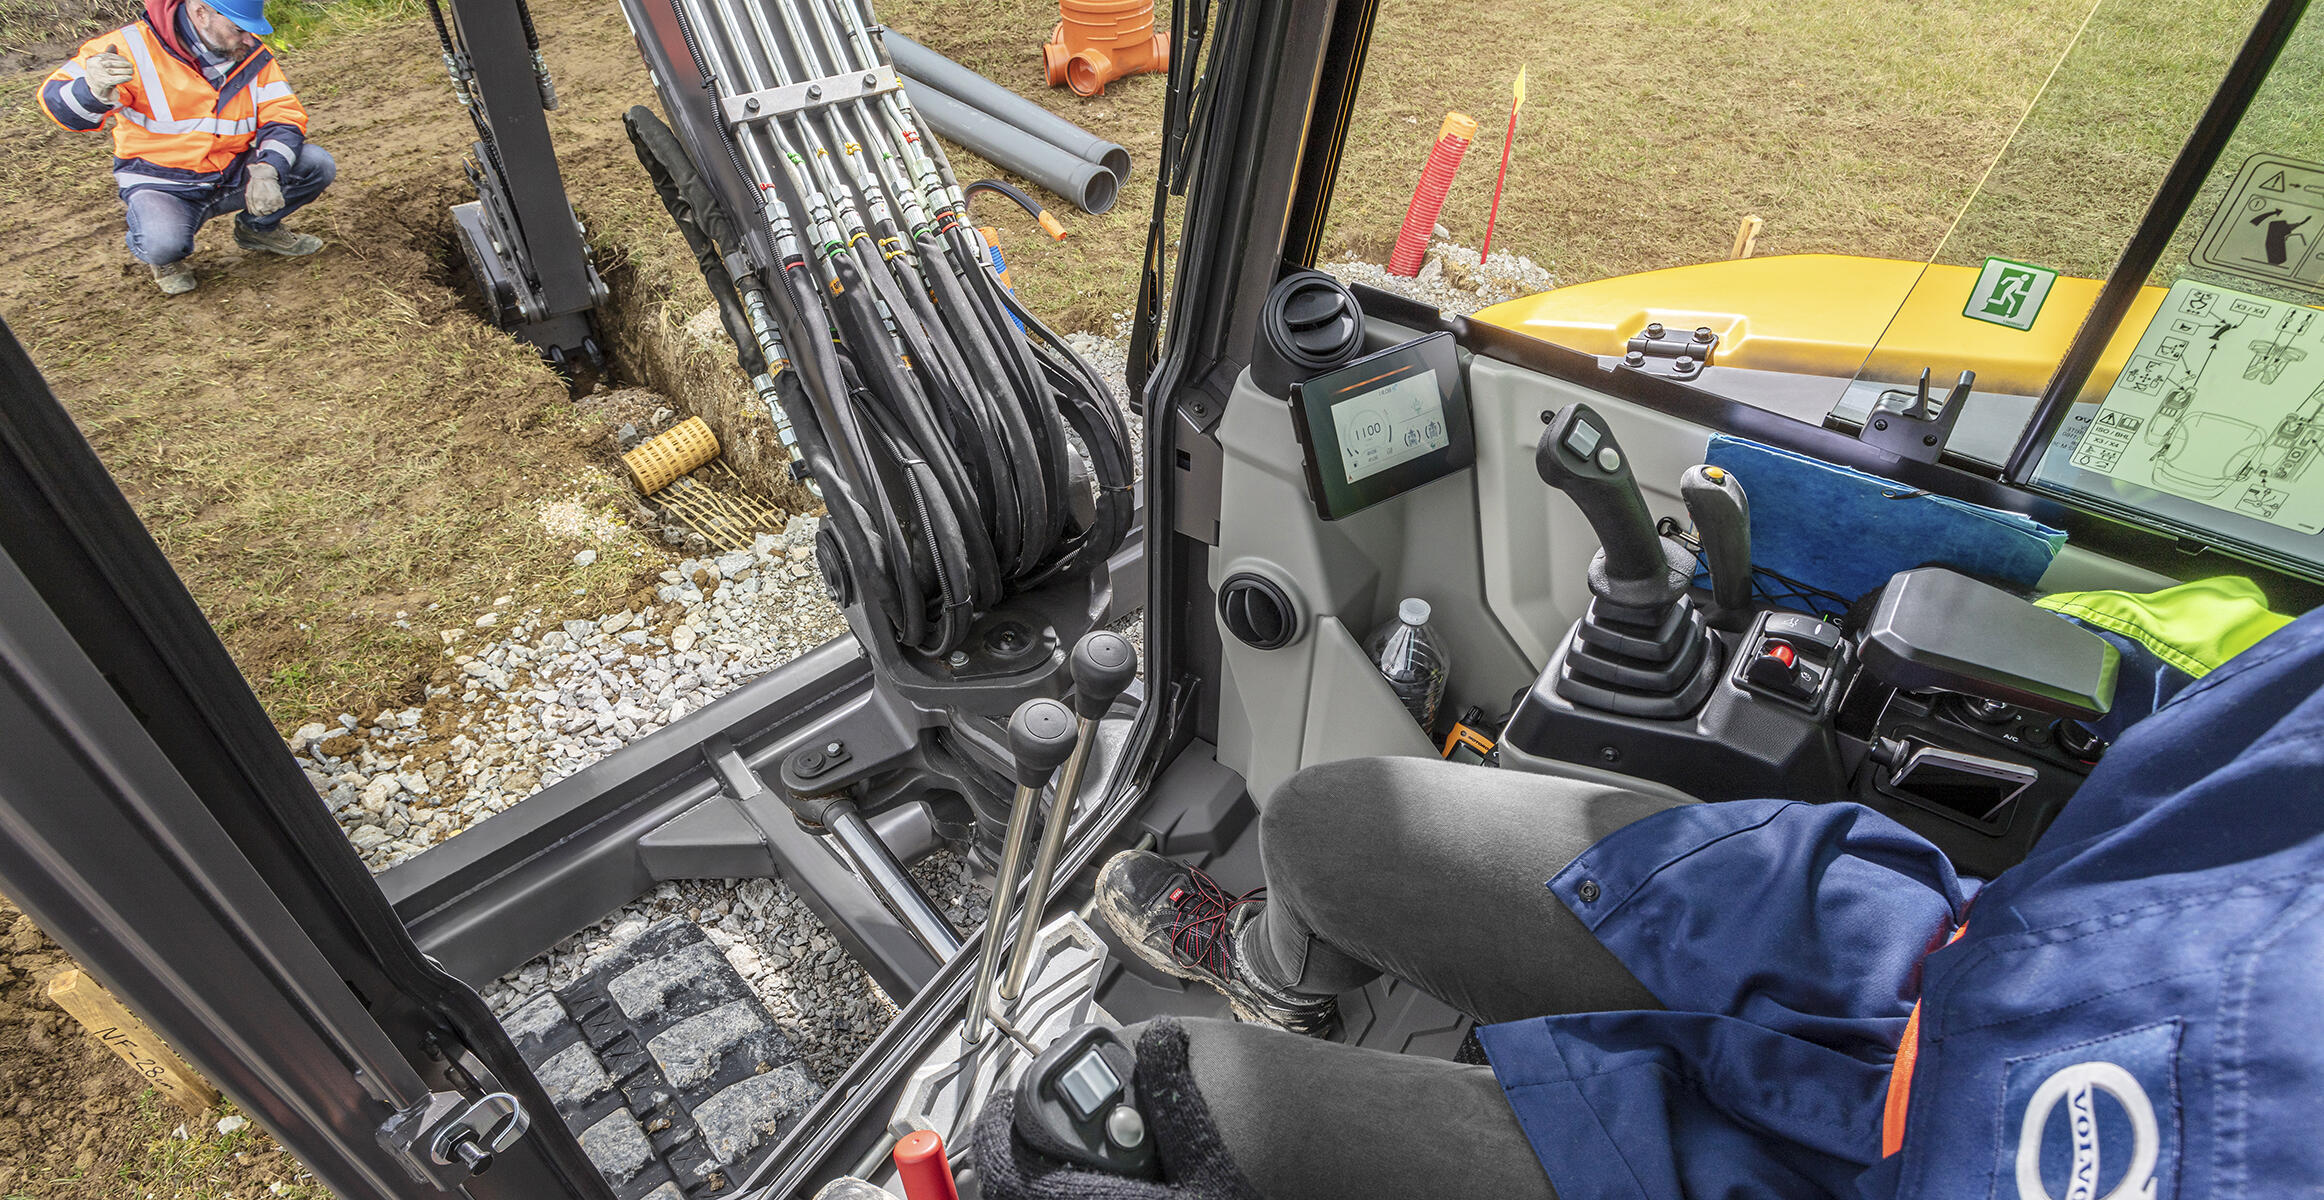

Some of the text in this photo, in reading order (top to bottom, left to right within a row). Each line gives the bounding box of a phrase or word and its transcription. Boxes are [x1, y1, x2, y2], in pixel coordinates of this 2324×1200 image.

[1355, 422, 1381, 441] 1100
[2095, 426, 2110, 435] ISO
[2074, 1089, 2093, 1200] VOLVO
